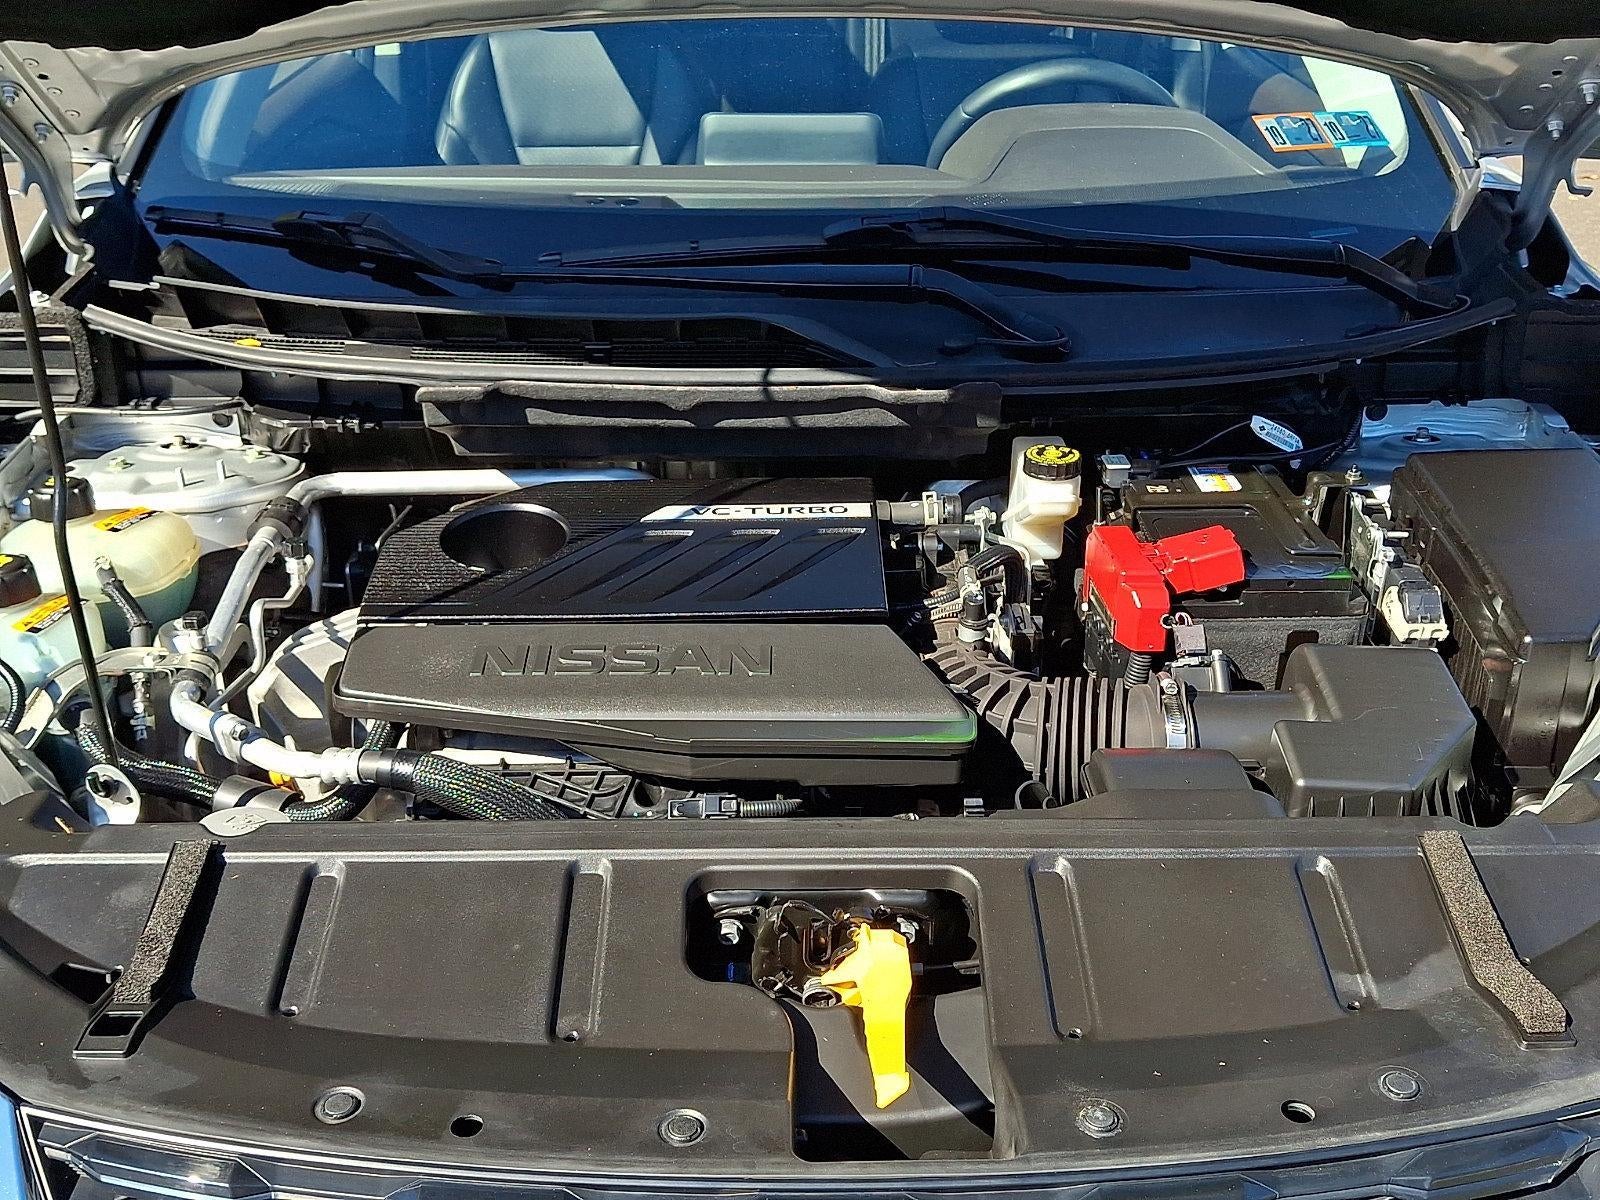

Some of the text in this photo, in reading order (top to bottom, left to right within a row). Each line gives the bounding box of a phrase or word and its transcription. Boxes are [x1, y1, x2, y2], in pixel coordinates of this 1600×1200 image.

[1264, 125, 1287, 145] 10
[1323, 121, 1346, 141] 10
[691, 502, 849, 517] VC-TURBO
[469, 644, 774, 677] NISSAN
